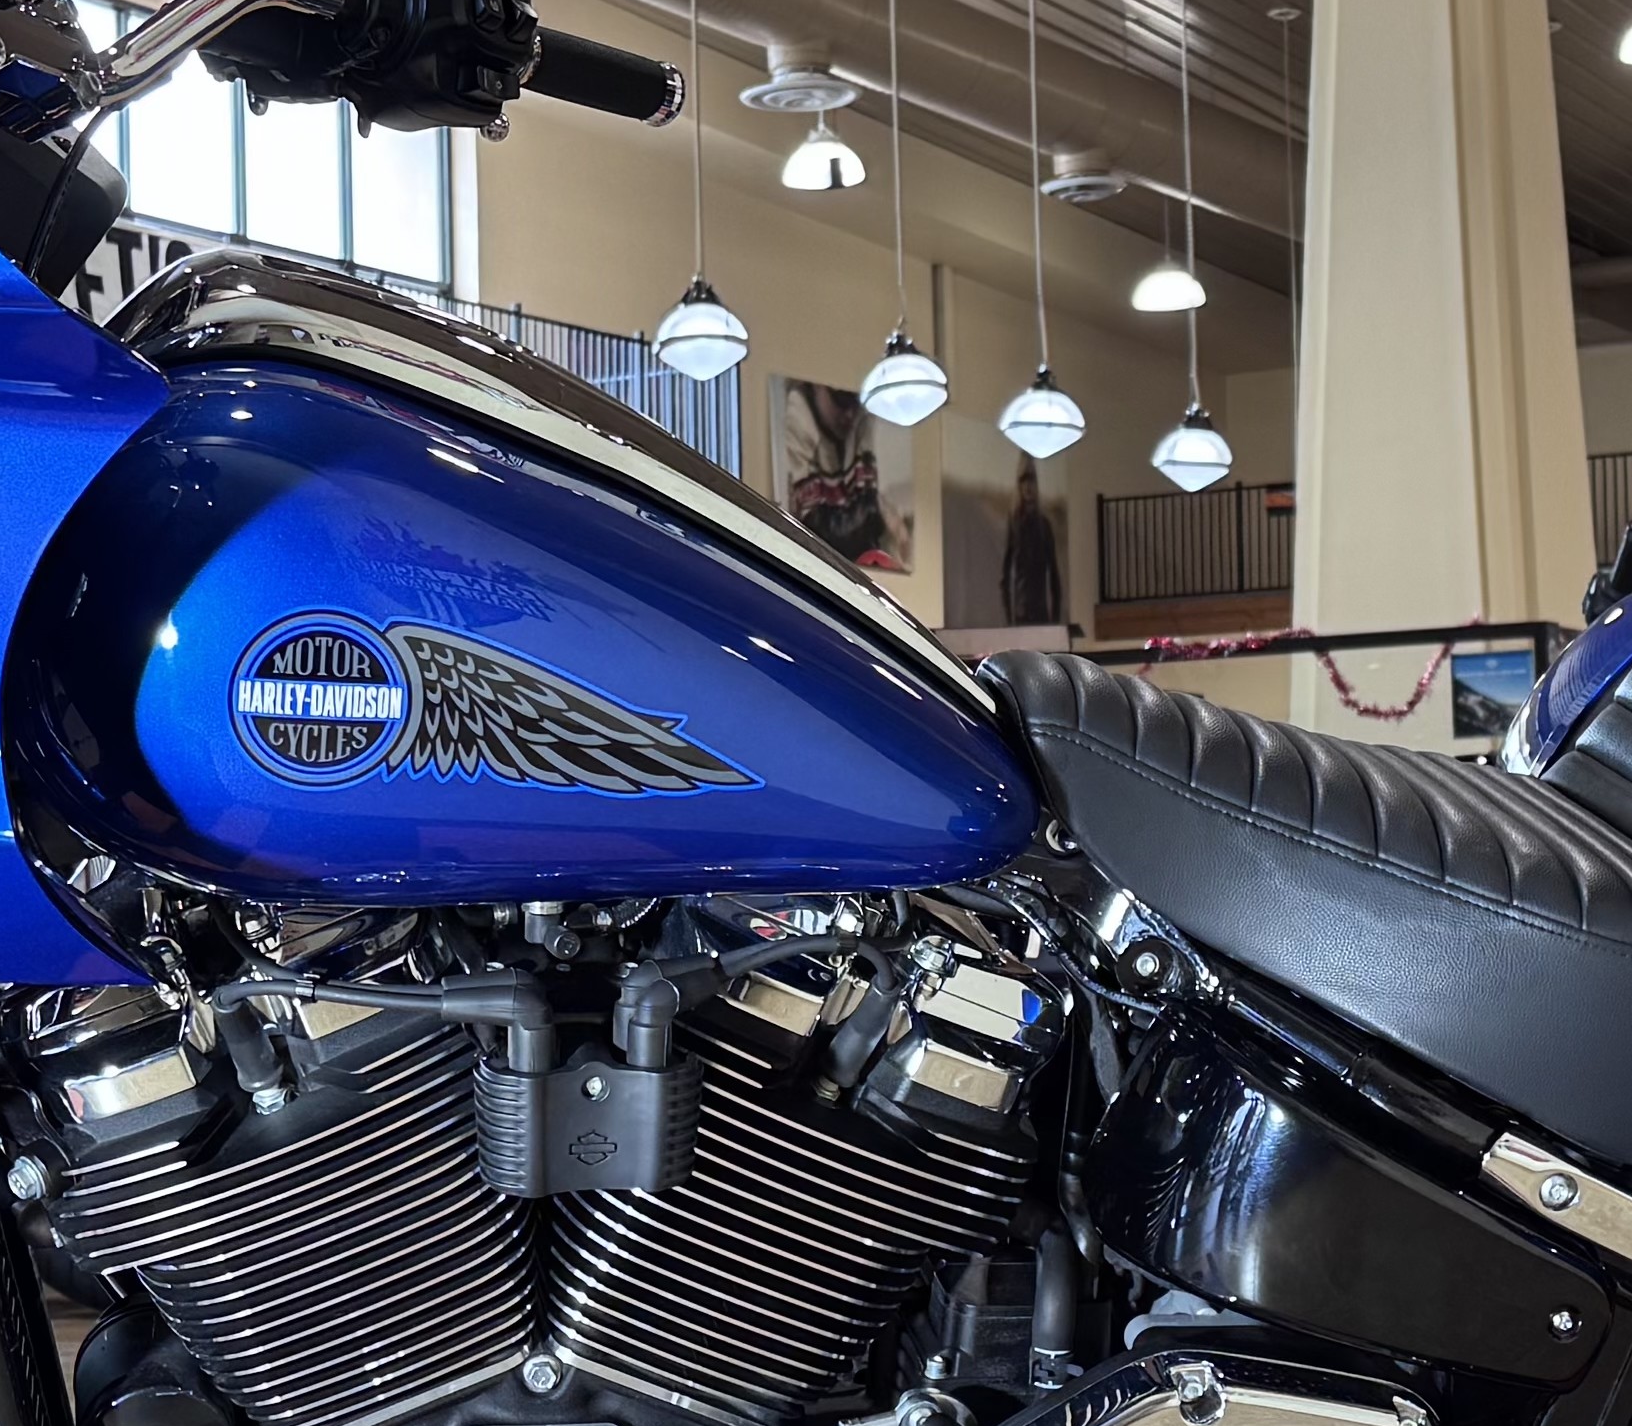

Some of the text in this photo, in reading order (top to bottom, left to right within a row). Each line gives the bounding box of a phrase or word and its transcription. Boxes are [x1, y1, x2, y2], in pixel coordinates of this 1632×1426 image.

[272, 636, 372, 679] MOTOR
[237, 679, 403, 720] HARLEY-DAVIDSON
[268, 722, 368, 763] CYCLES
